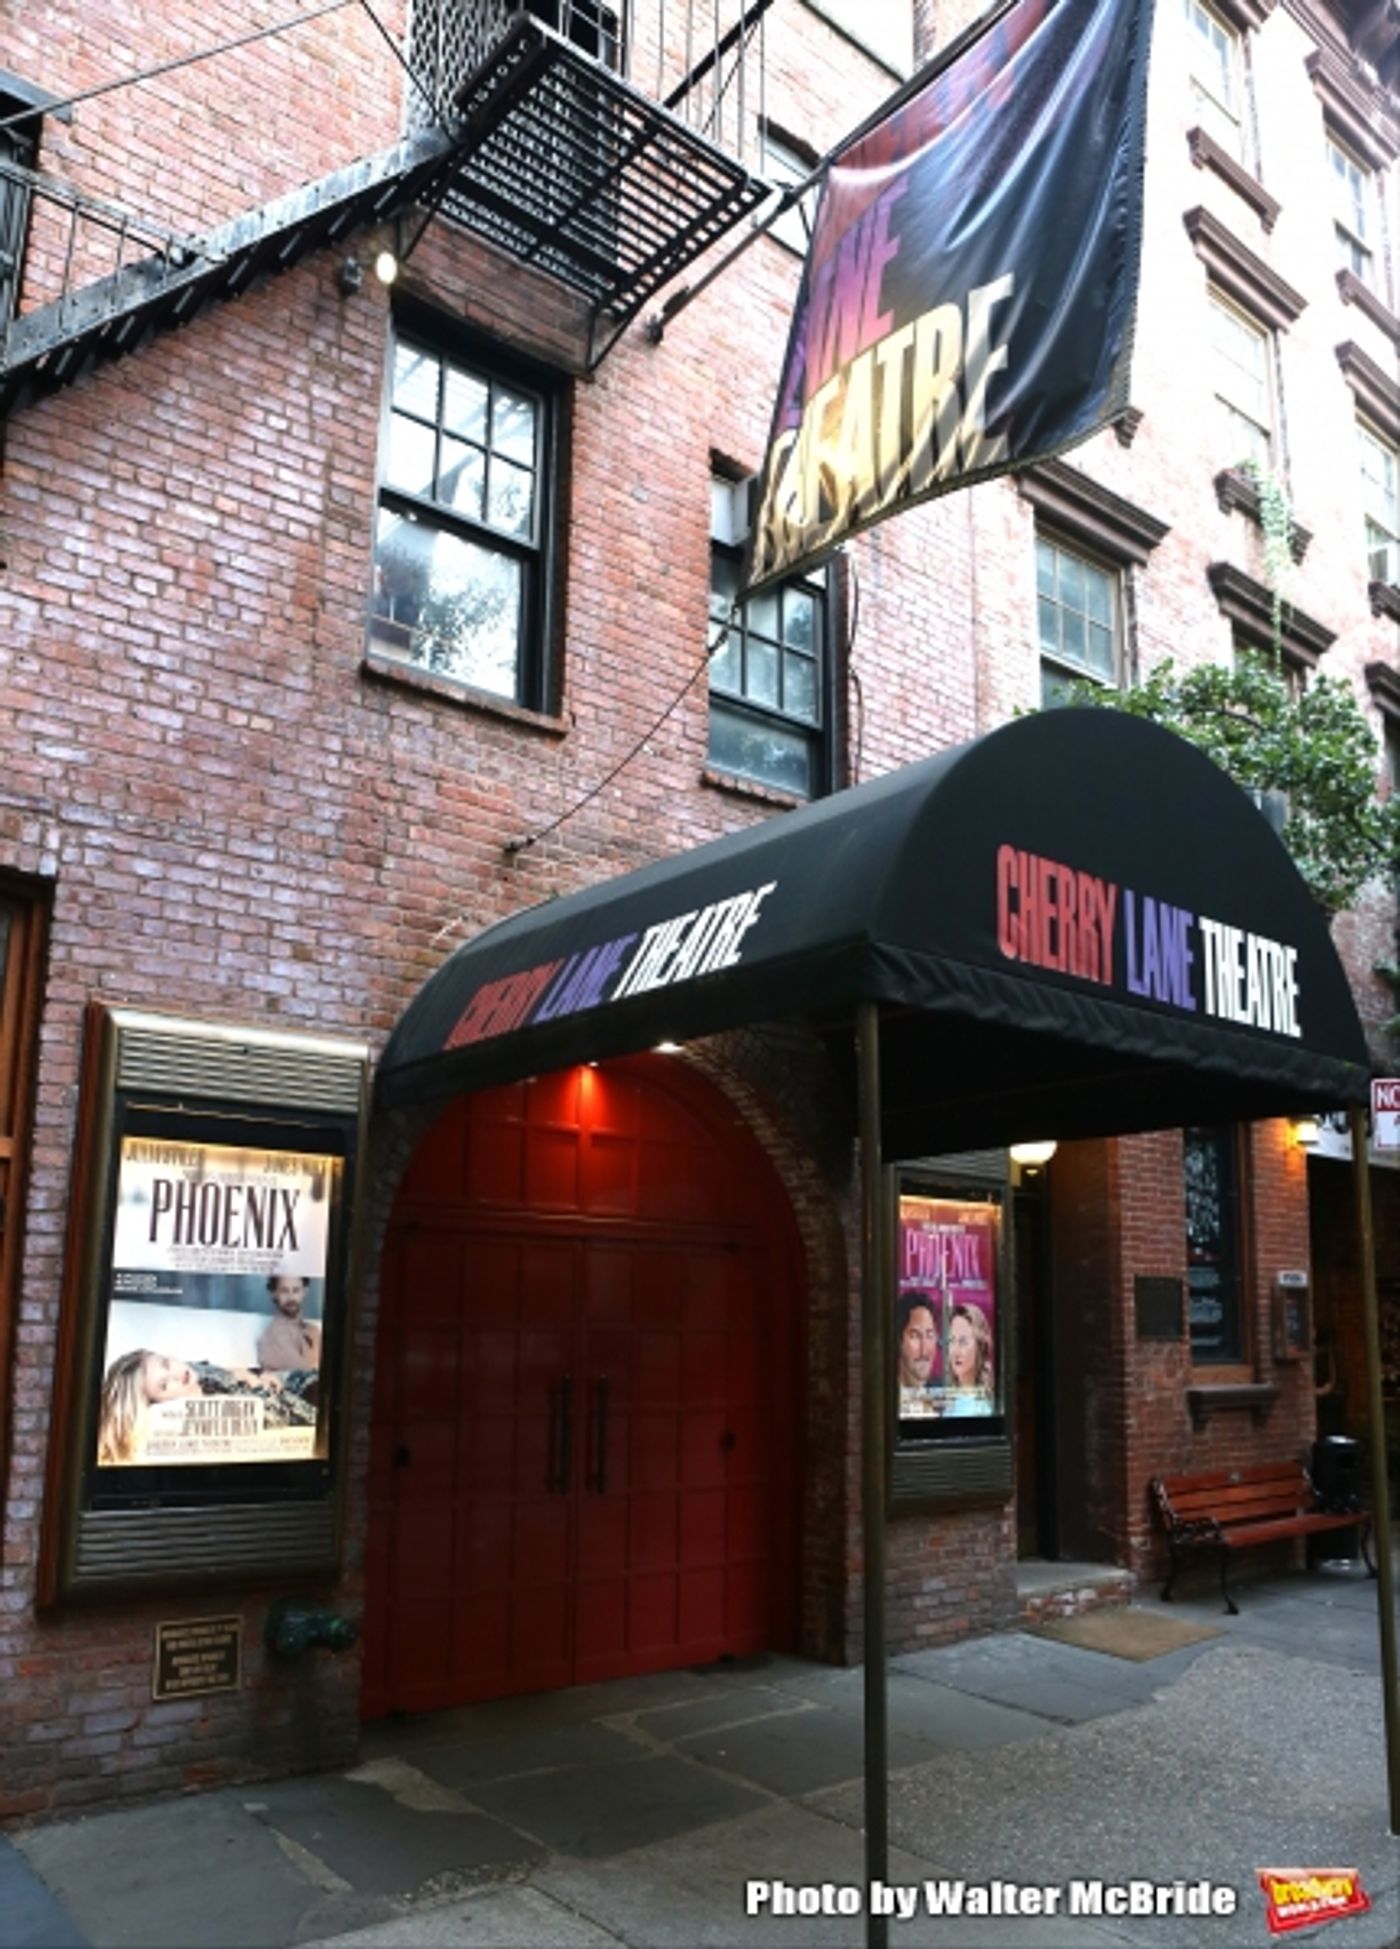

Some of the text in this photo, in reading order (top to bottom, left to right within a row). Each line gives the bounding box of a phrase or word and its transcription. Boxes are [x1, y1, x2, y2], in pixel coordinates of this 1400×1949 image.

[533, 931, 638, 1025] LANE
[610, 880, 778, 1002] THEATRE
[997, 843, 1301, 1038] CHERRY LANE THEATRE
[149, 1178, 301, 1251] PHOENIX
[906, 1229, 980, 1278] PHOENIX
